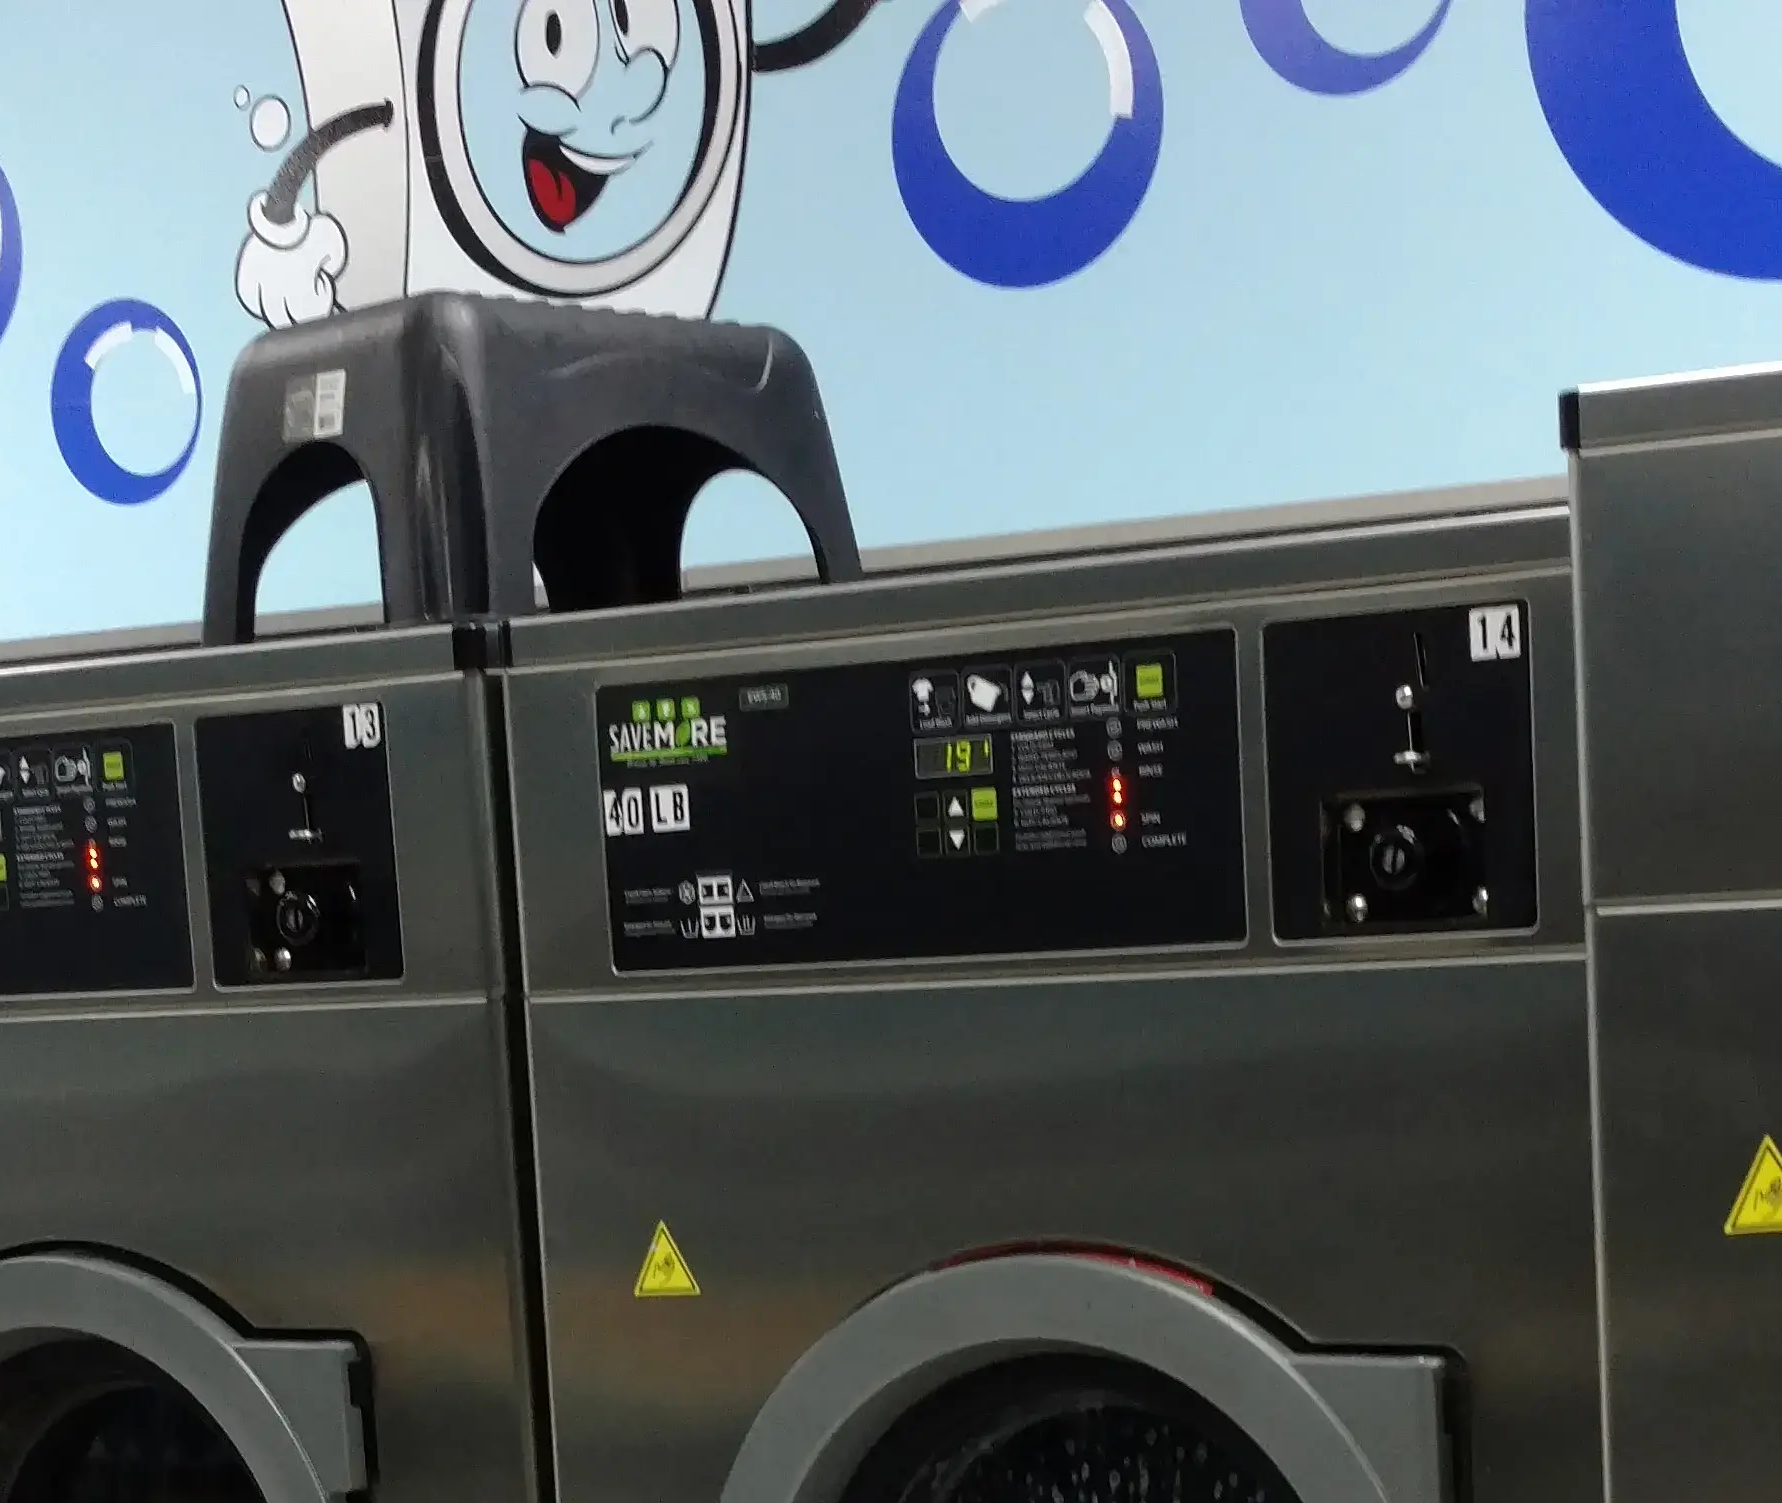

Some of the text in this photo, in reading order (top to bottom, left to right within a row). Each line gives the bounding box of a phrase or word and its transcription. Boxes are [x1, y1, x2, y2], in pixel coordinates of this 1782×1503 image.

[1478, 613, 1515, 650] 14
[349, 709, 376, 740] 13
[608, 790, 685, 828] 40 LB
